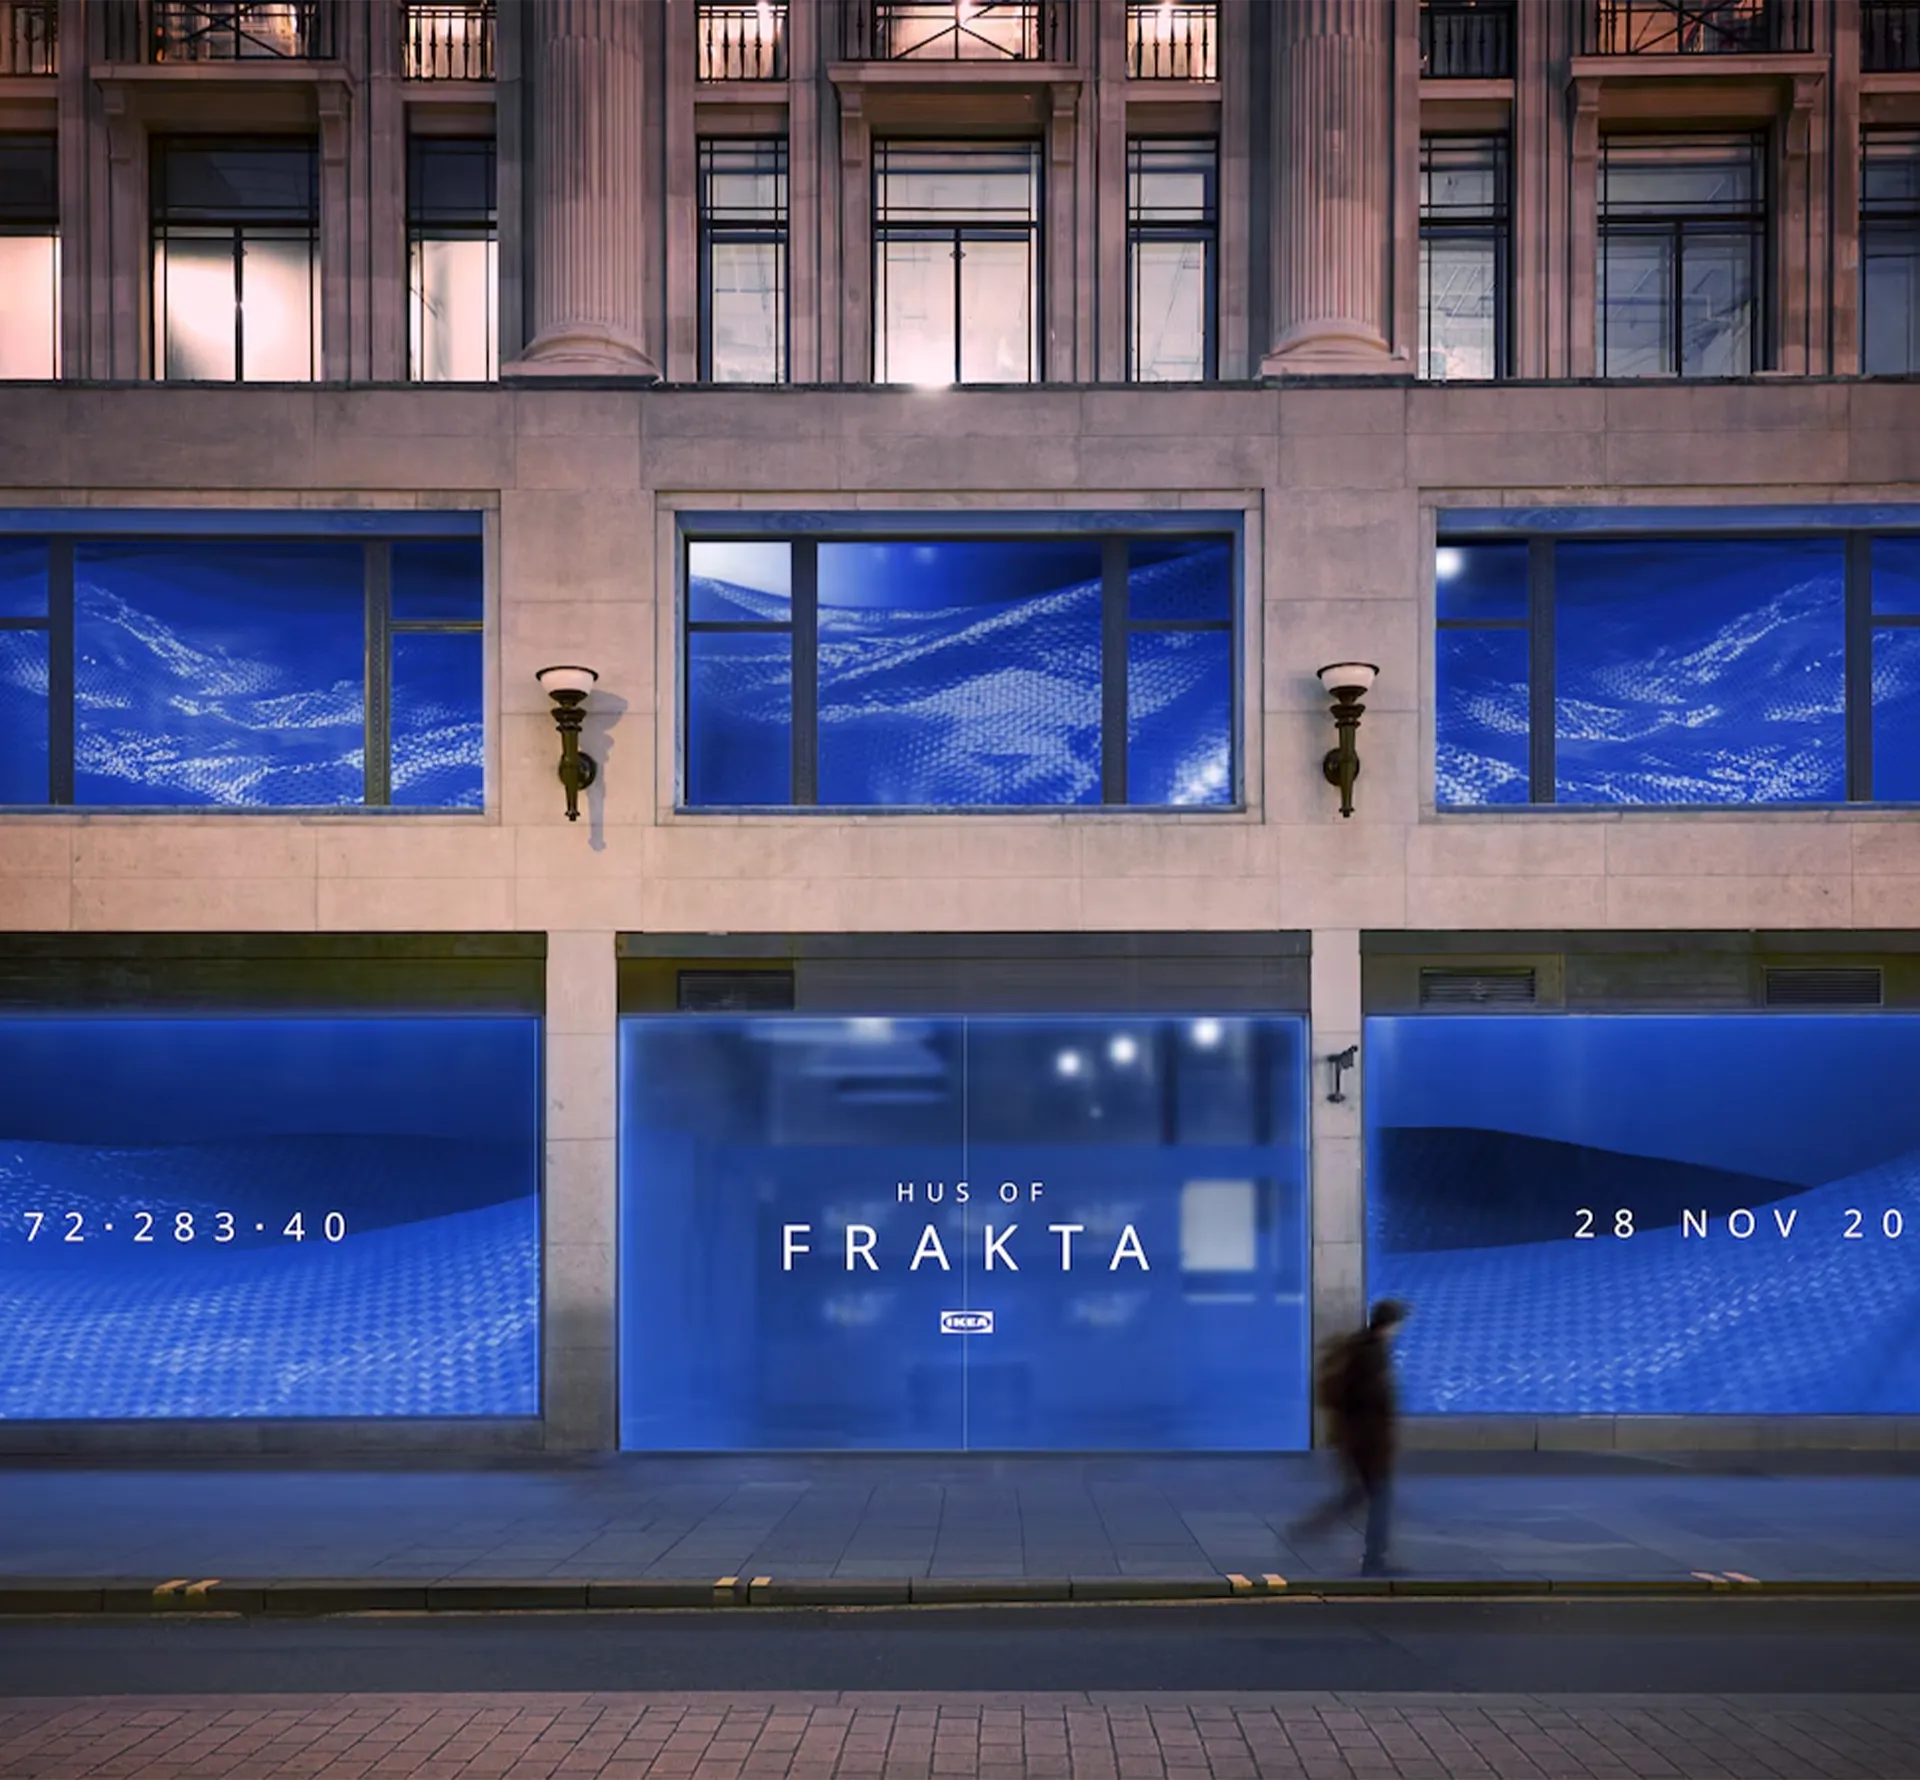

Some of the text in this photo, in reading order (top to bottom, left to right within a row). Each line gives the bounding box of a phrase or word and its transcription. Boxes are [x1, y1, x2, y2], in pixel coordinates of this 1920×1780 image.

[898, 1182, 1044, 1202] HUS OF
[1574, 1208, 1635, 1238] 28
[1683, 1208, 1797, 1238] NOV
[782, 1224, 1150, 1271] FRAKTA
[944, 1315, 989, 1329] IKEA
